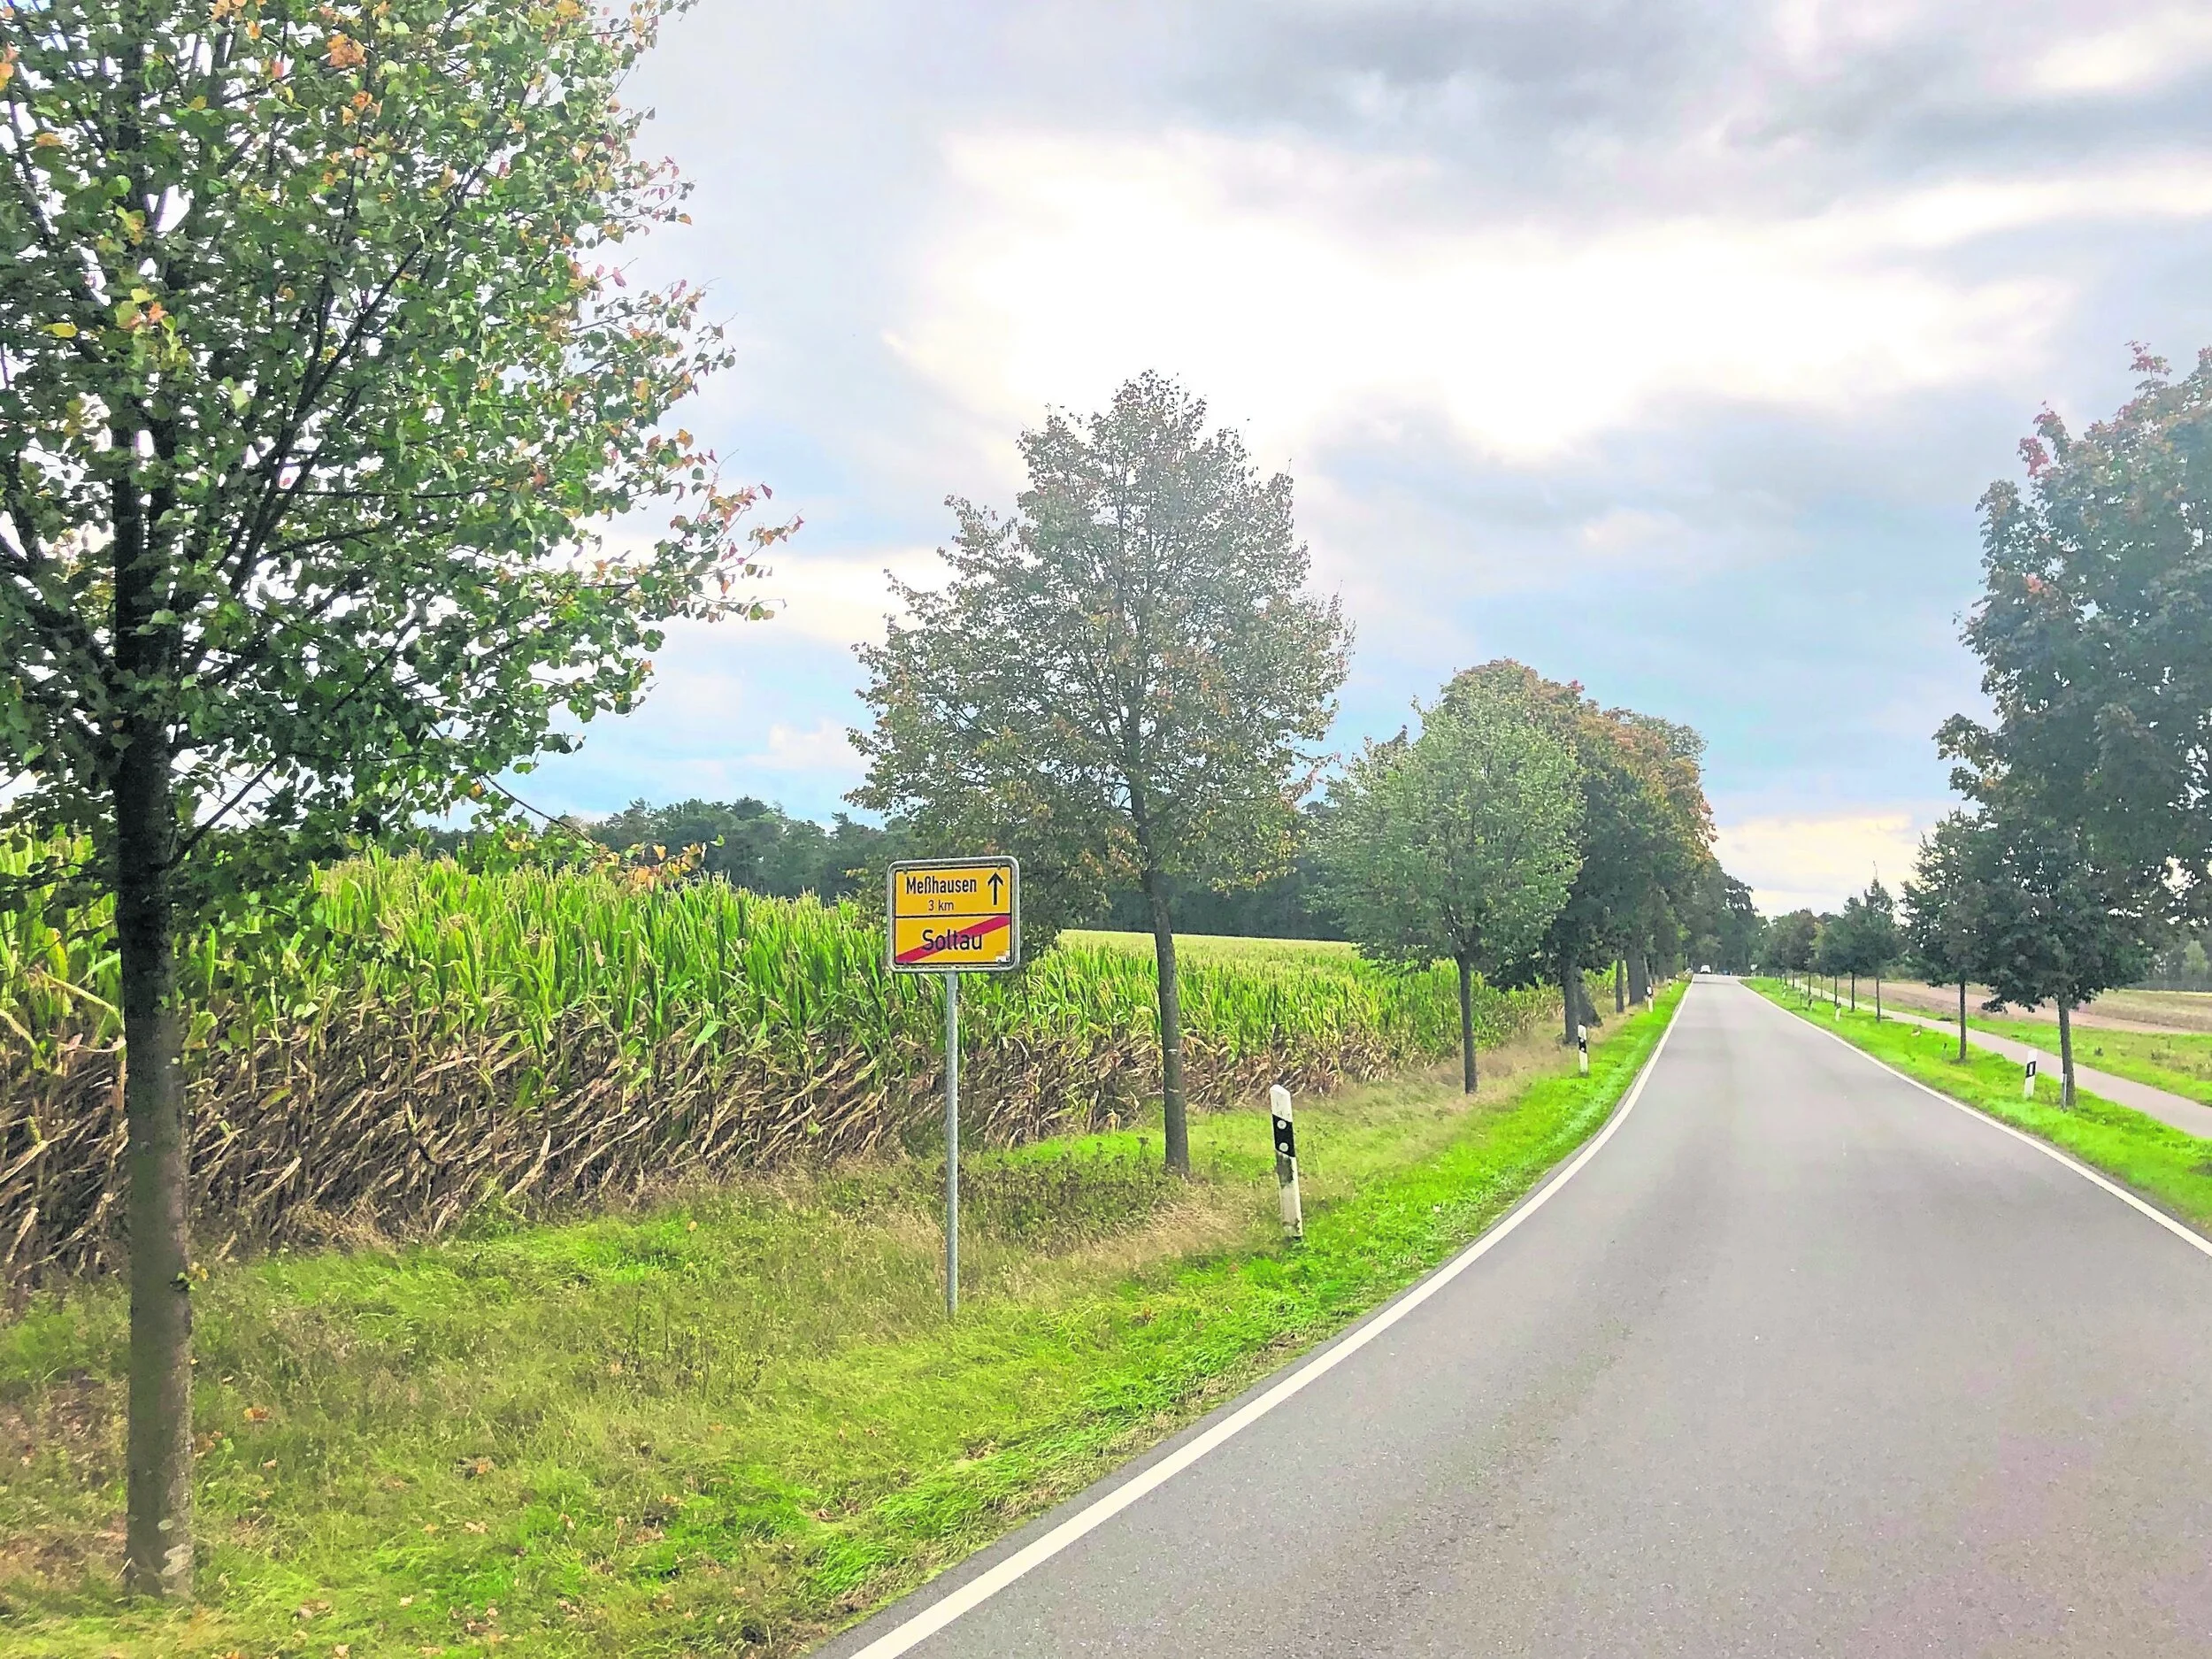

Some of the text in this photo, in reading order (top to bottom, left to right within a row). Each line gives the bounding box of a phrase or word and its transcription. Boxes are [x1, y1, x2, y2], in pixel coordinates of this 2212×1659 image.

[906, 875, 977, 895] Meßhausen
[928, 899, 954, 911] 3 km
[922, 929, 982, 951] Soltau
